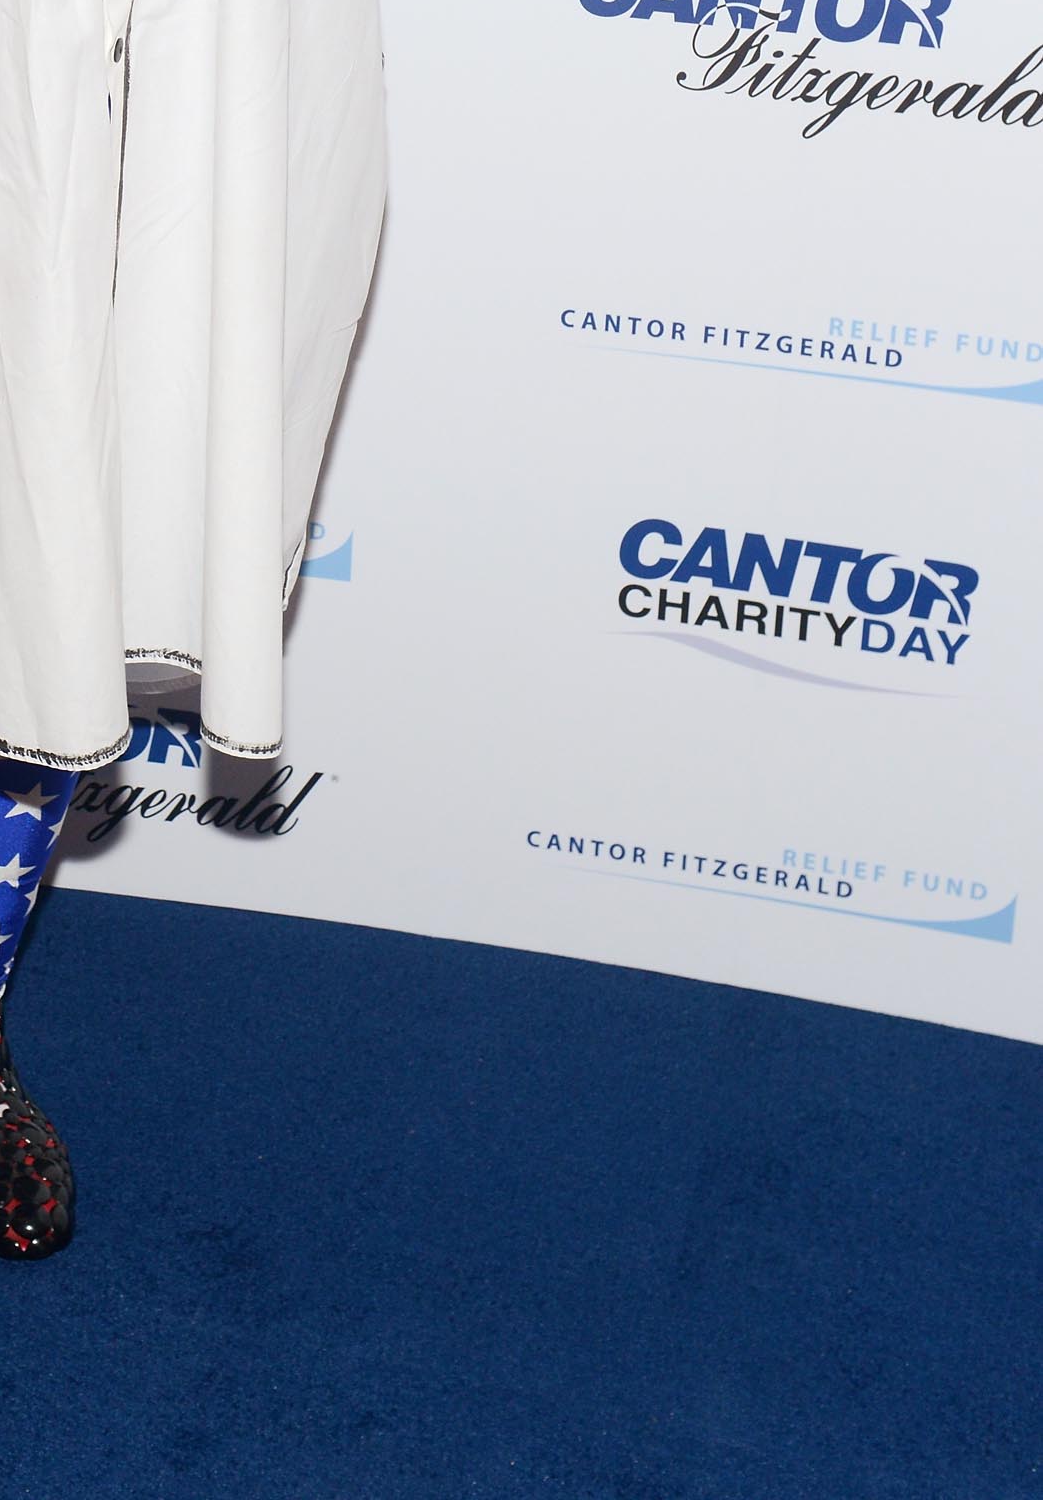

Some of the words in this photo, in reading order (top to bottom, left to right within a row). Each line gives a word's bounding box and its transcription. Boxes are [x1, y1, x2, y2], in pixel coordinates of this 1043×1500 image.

[561, 309, 686, 341] CANTOR
[703, 326, 903, 368] FITZGERALD
[829, 317, 938, 349] RELIEF
[955, 334, 1043, 363] FUND
[619, 518, 979, 625] CANTOR
[70, 765, 324, 842] zgerald
[527, 830, 646, 865] CANTOR
[663, 851, 853, 899] FITZGERALD
[783, 849, 887, 881] RELIEF
[903, 870, 989, 901] FUND
